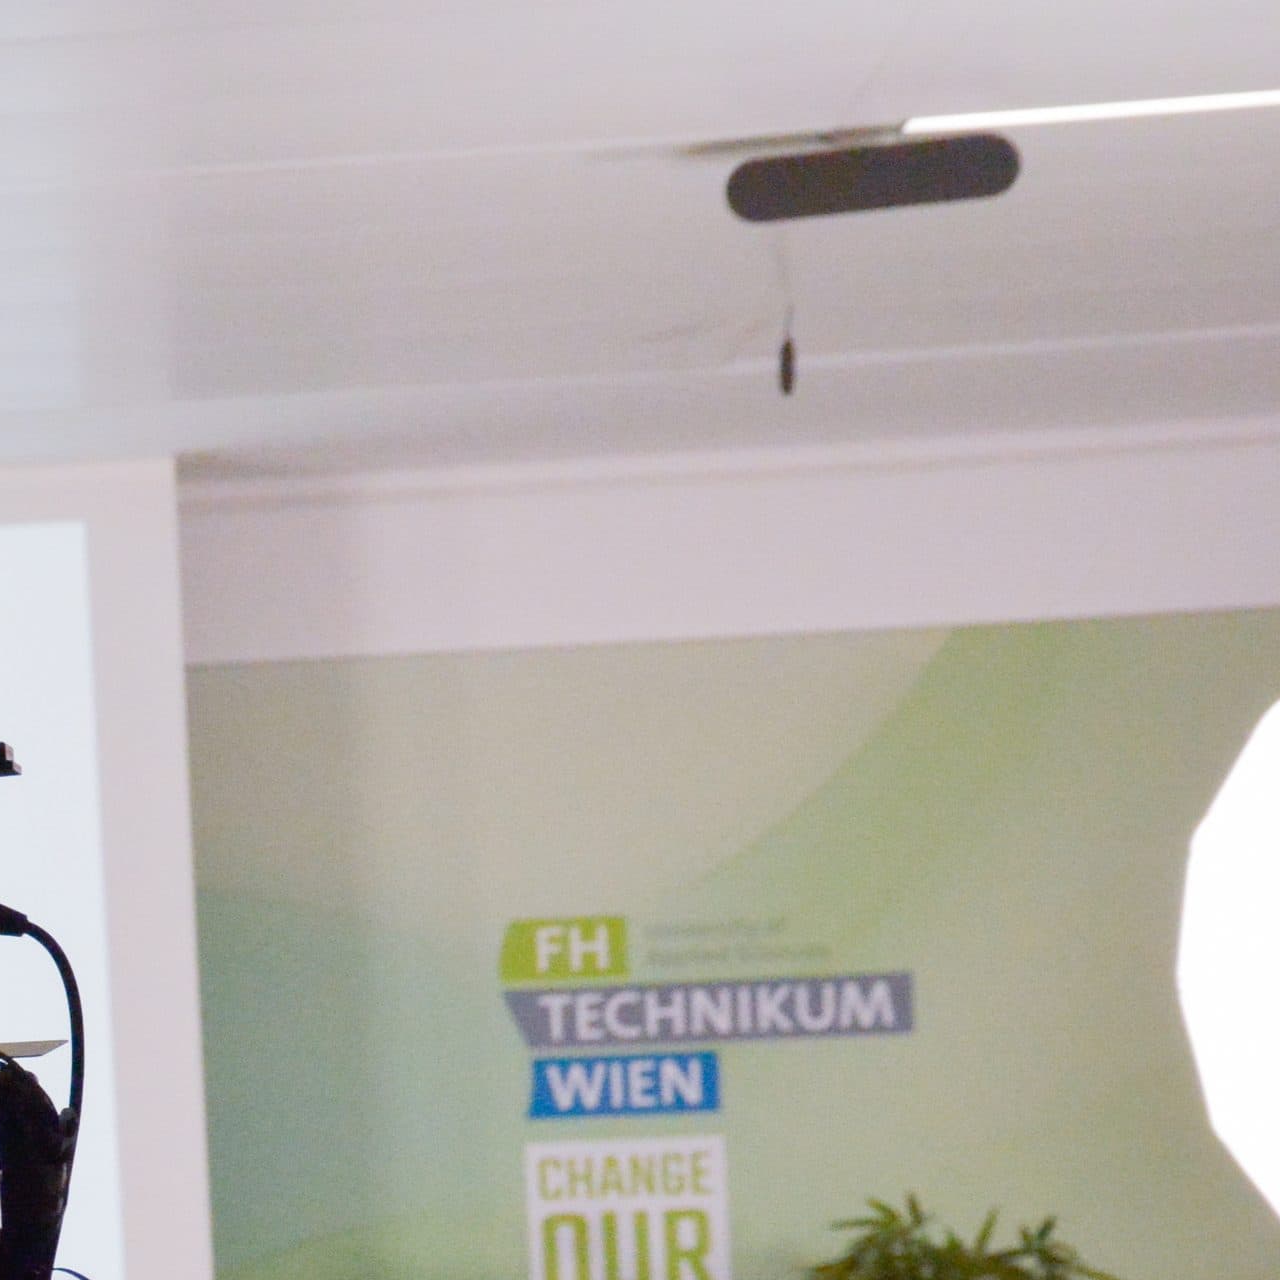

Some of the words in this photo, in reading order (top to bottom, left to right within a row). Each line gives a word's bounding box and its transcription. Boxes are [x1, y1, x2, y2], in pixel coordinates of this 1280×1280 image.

[535, 923, 610, 973] FH
[540, 980, 896, 1042] TECHNIKUM
[546, 1058, 703, 1111] WIEN
[536, 1149, 714, 1200] CHANGE
